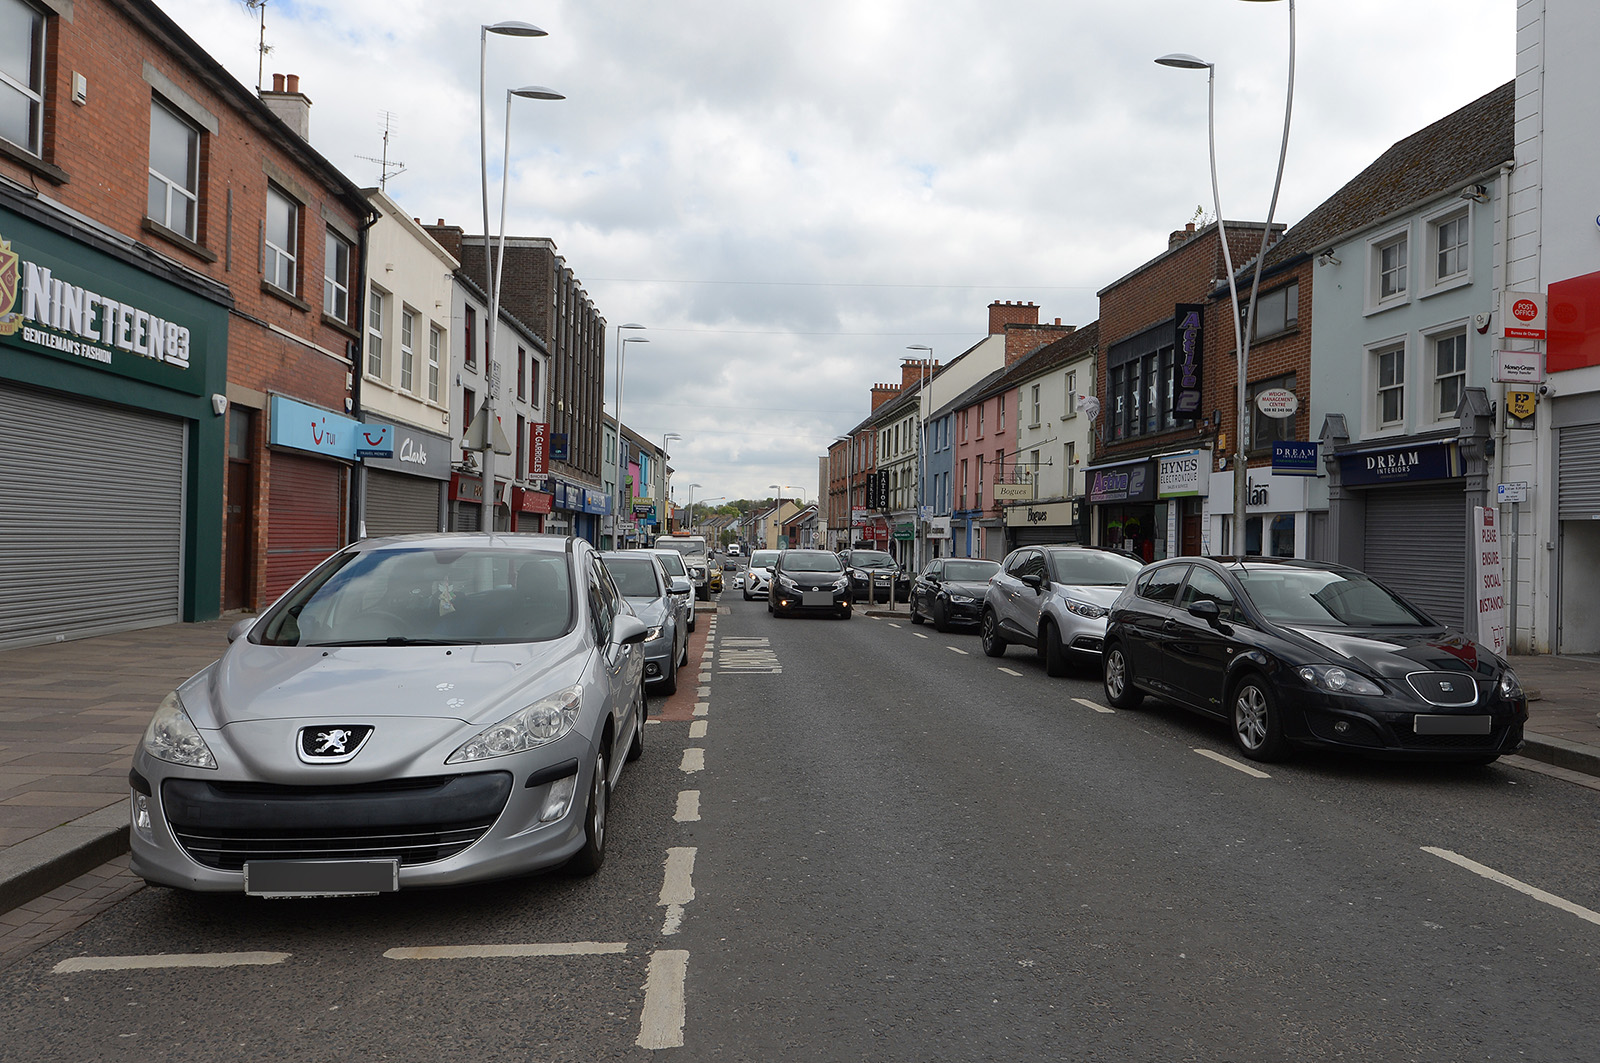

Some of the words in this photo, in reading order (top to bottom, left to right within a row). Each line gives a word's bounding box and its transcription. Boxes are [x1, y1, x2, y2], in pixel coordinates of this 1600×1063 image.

[1514, 309, 1535, 317] OFFICE
[23, 326, 80, 356] GENTLEMAN'S
[80, 343, 112, 364] FASHION
[1176, 389, 1201, 412] 2
[326, 432, 336, 446] TUI
[400, 437, 427, 465] Clarks
[1276, 448, 1315, 457] DREAM
[1161, 458, 1198, 474] HYNES
[1366, 451, 1419, 470] DREAM
[1376, 465, 1411, 474] INTERIORS
[1090, 470, 1129, 495] Active
[1160, 472, 1197, 484] ELECTRONIQUE
[1000, 487, 1027, 496] Bogues
[1246, 476, 1268, 506] lan
[1027, 507, 1047, 525] Bogues
[1482, 529, 1497, 543] PLEASE
[1482, 551, 1500, 566] ENSURE
[1483, 573, 1502, 589] SOCIAL
